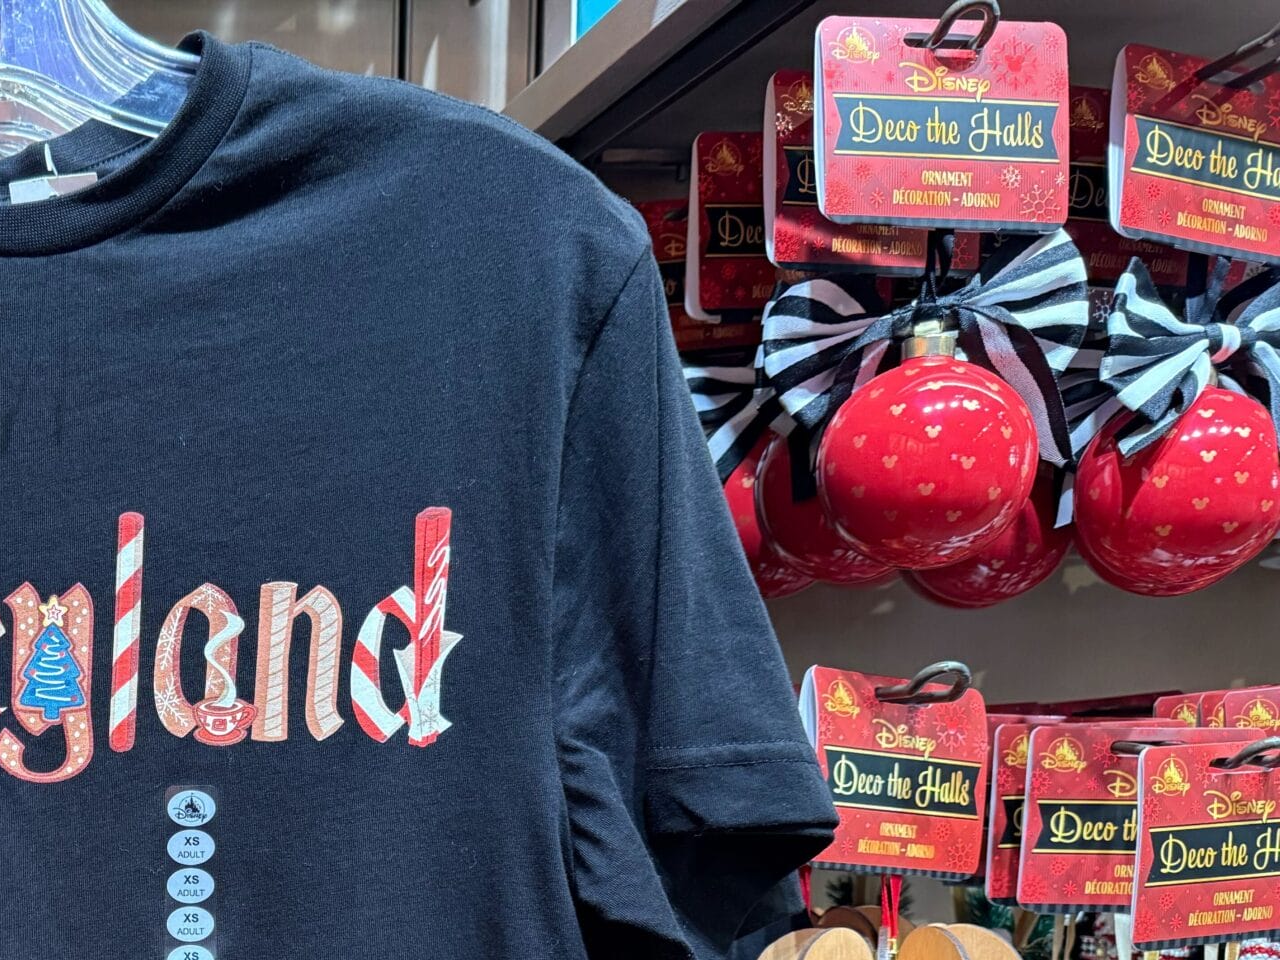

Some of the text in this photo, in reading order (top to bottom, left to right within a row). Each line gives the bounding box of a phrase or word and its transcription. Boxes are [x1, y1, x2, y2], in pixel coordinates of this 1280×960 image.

[850, 101, 921, 143] Deco
[926, 106, 960, 145] the
[968, 107, 1045, 153] Halls
[1146, 124, 1206, 171] Deco
[1209, 139, 1238, 179] the
[921, 170, 974, 187] ORNAMENT
[892, 188, 951, 206] DÉCORATION
[961, 191, 1000, 209] ADORNO
[1202, 198, 1246, 220] ORNAMENT
[718, 210, 763, 247] Dec
[1176, 210, 1226, 234] DÉCORATION
[1233, 224, 1268, 242] ADORNO
[833, 754, 970, 808] Deco the Halls
[1050, 806, 1119, 843] Deco
[1122, 808, 1138, 842] th
[184, 836, 200, 846] XS
[177, 851, 206, 859] ADULT
[1160, 832, 1218, 874] Deco
[1220, 830, 1249, 867] the
[183, 875, 200, 885] XS
[1084, 878, 1134, 895] DÉCORATIO
[177, 889, 205, 897] ADULT
[1213, 888, 1255, 906] ORNAMENT
[183, 914, 199, 923] XS
[1188, 906, 1235, 927] DÉCORATION
[1242, 905, 1273, 922] ADORNO
[183, 952, 200, 960] XS
